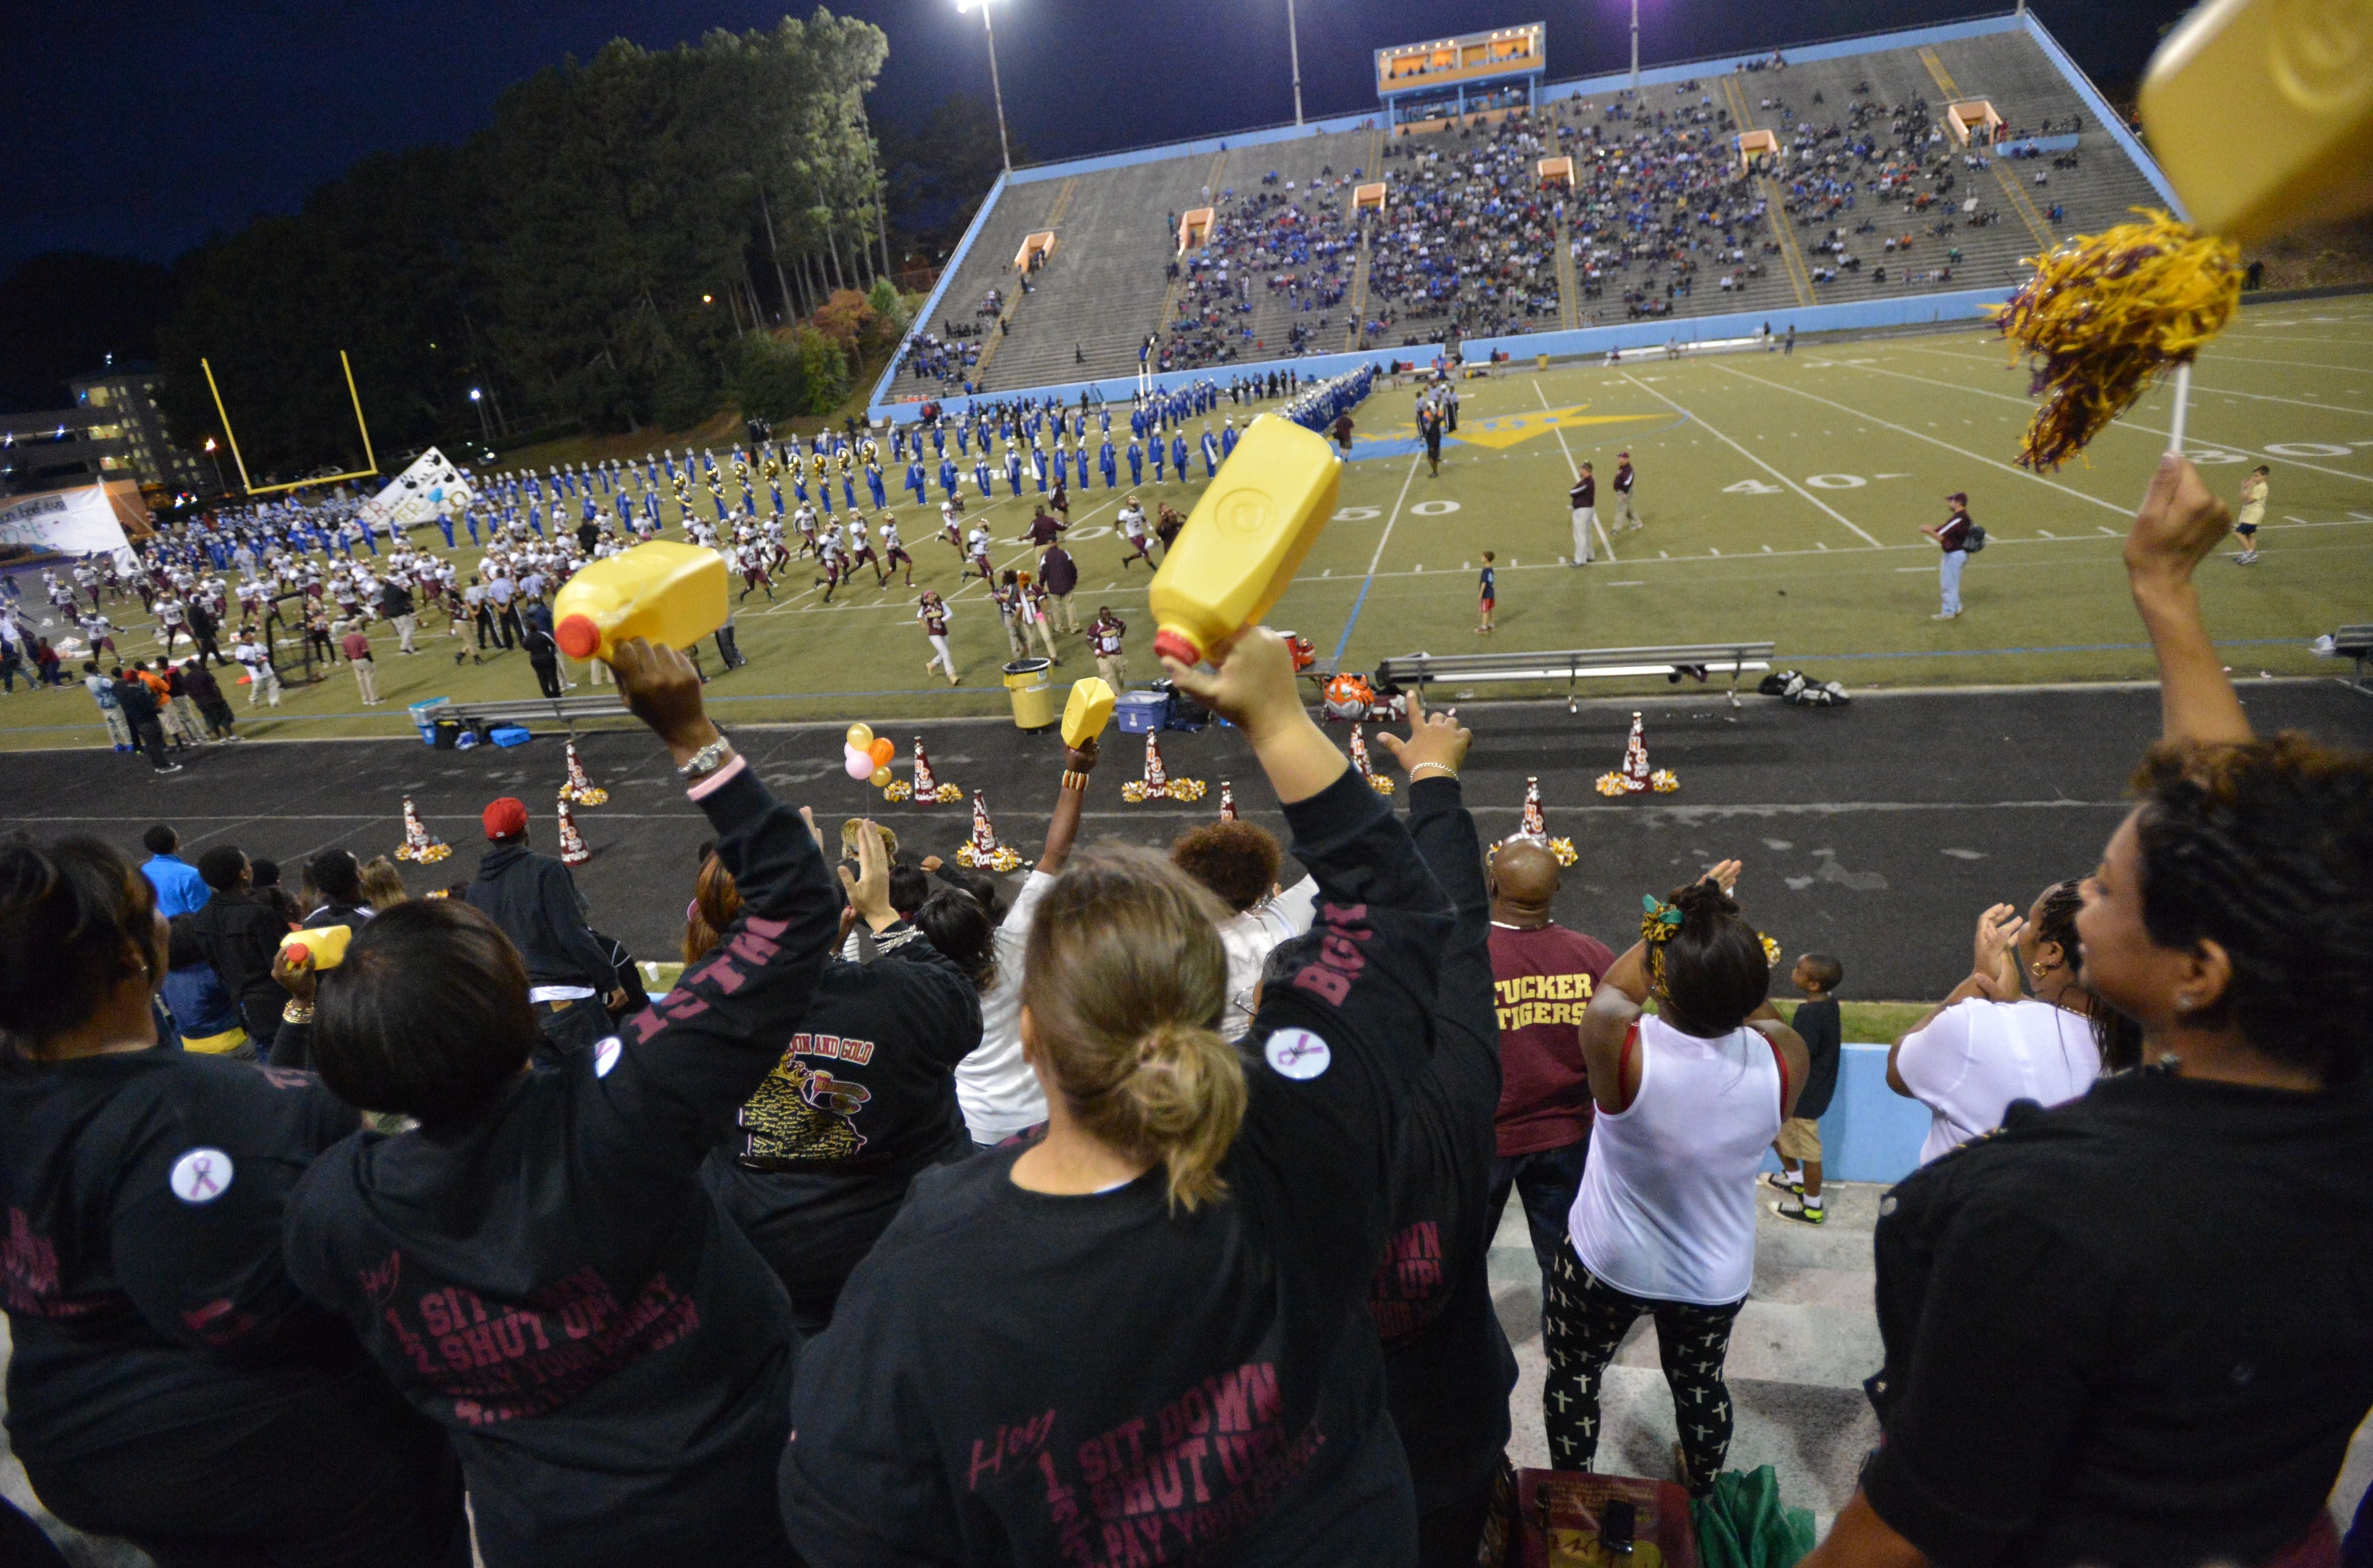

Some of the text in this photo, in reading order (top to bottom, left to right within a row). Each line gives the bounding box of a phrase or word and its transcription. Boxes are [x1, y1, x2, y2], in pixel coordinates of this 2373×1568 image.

[1722, 473, 1867, 495] 40
[1494, 973, 1593, 1006] TUCKER
[1496, 1001, 1587, 1031] TIGERS
[814, 1034, 840, 1059] AND
[839, 1038, 875, 1066] GOLD
[440, 1305, 551, 1372] SHUT
[1077, 1415, 1148, 1484] SIT
[1157, 1362, 1285, 1448] DOWN
[1091, 1436, 1212, 1520] SHUT
